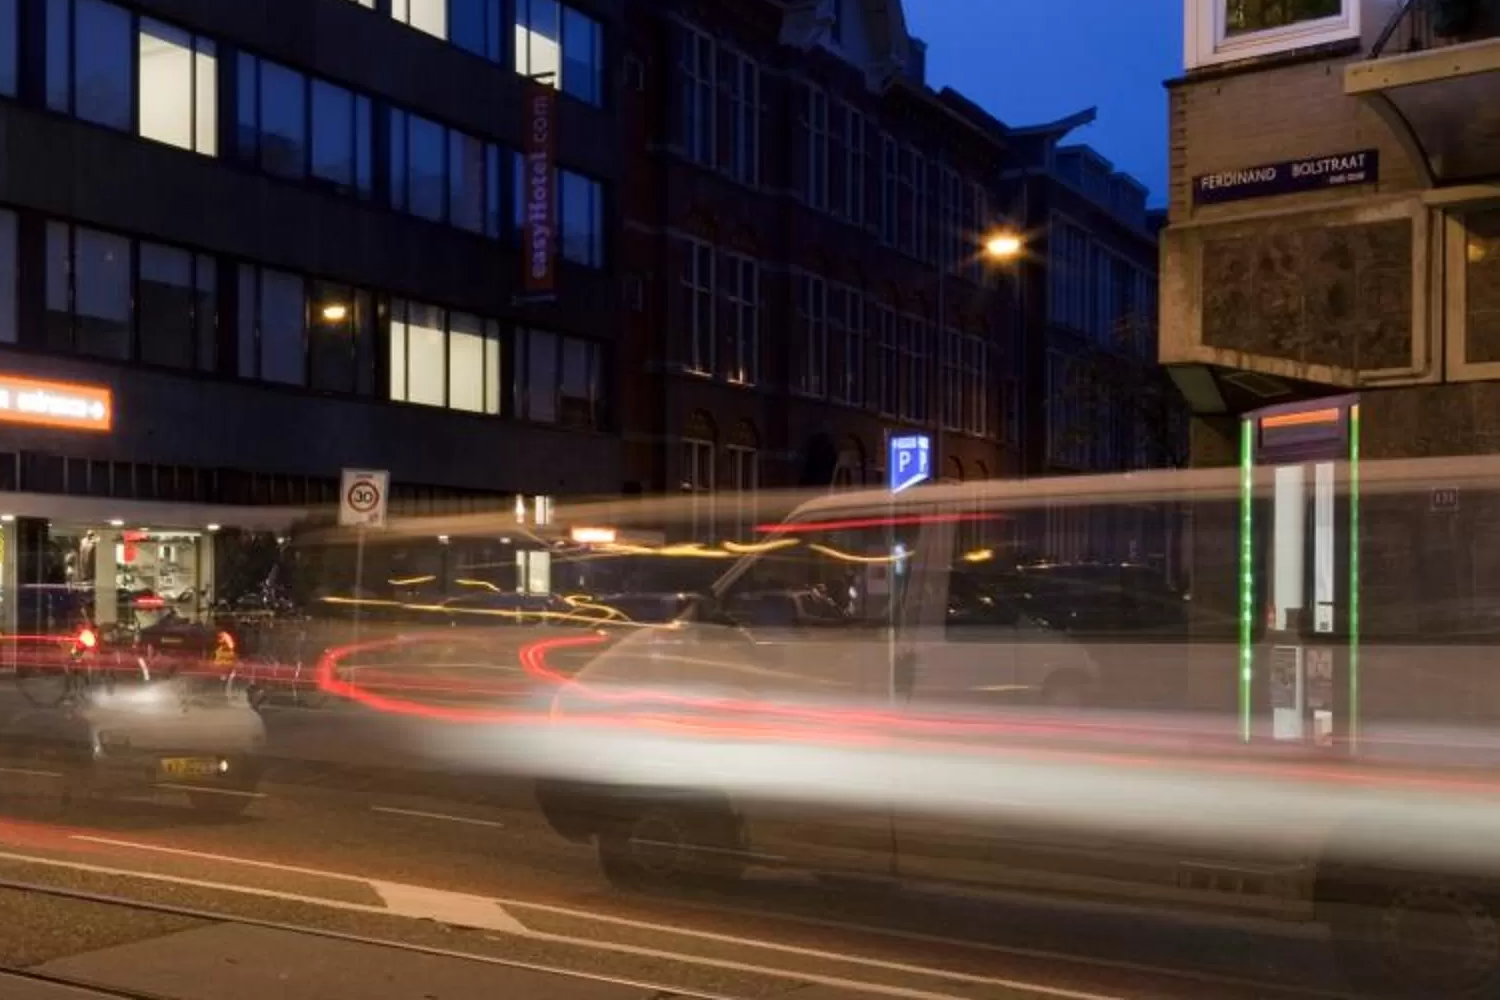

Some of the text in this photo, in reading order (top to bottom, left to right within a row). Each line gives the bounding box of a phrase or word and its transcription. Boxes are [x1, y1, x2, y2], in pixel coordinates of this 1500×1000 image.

[1201, 167, 1277, 191] FERDINAND
[1291, 153, 1366, 179] BOLSTRAAT
[899, 450, 911, 473] P
[354, 489, 373, 504] 30
